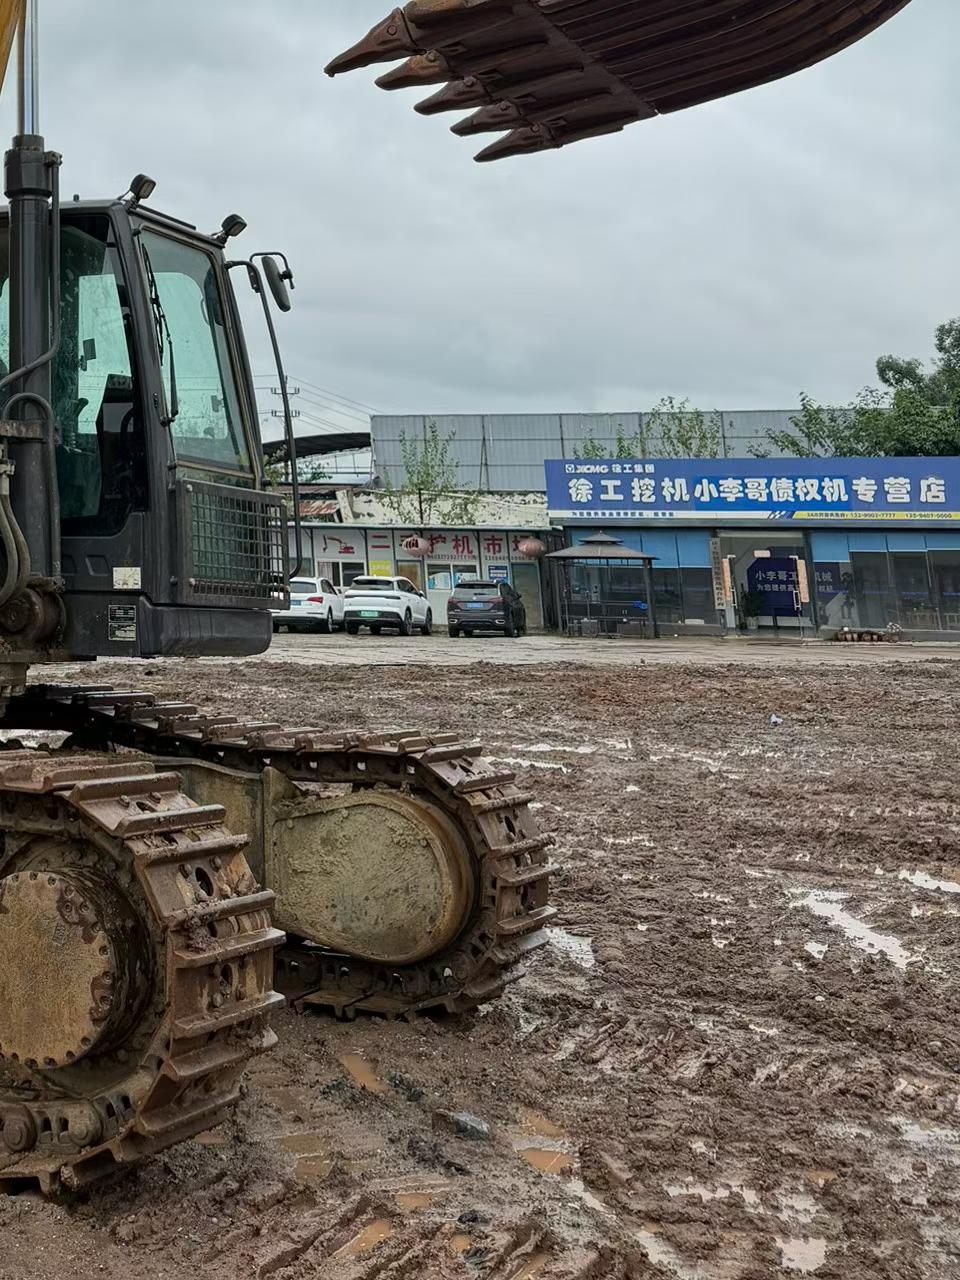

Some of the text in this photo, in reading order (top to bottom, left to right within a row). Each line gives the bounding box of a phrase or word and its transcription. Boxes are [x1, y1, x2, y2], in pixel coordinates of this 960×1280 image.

[576, 463, 655, 474] XCMG 徐工集团
